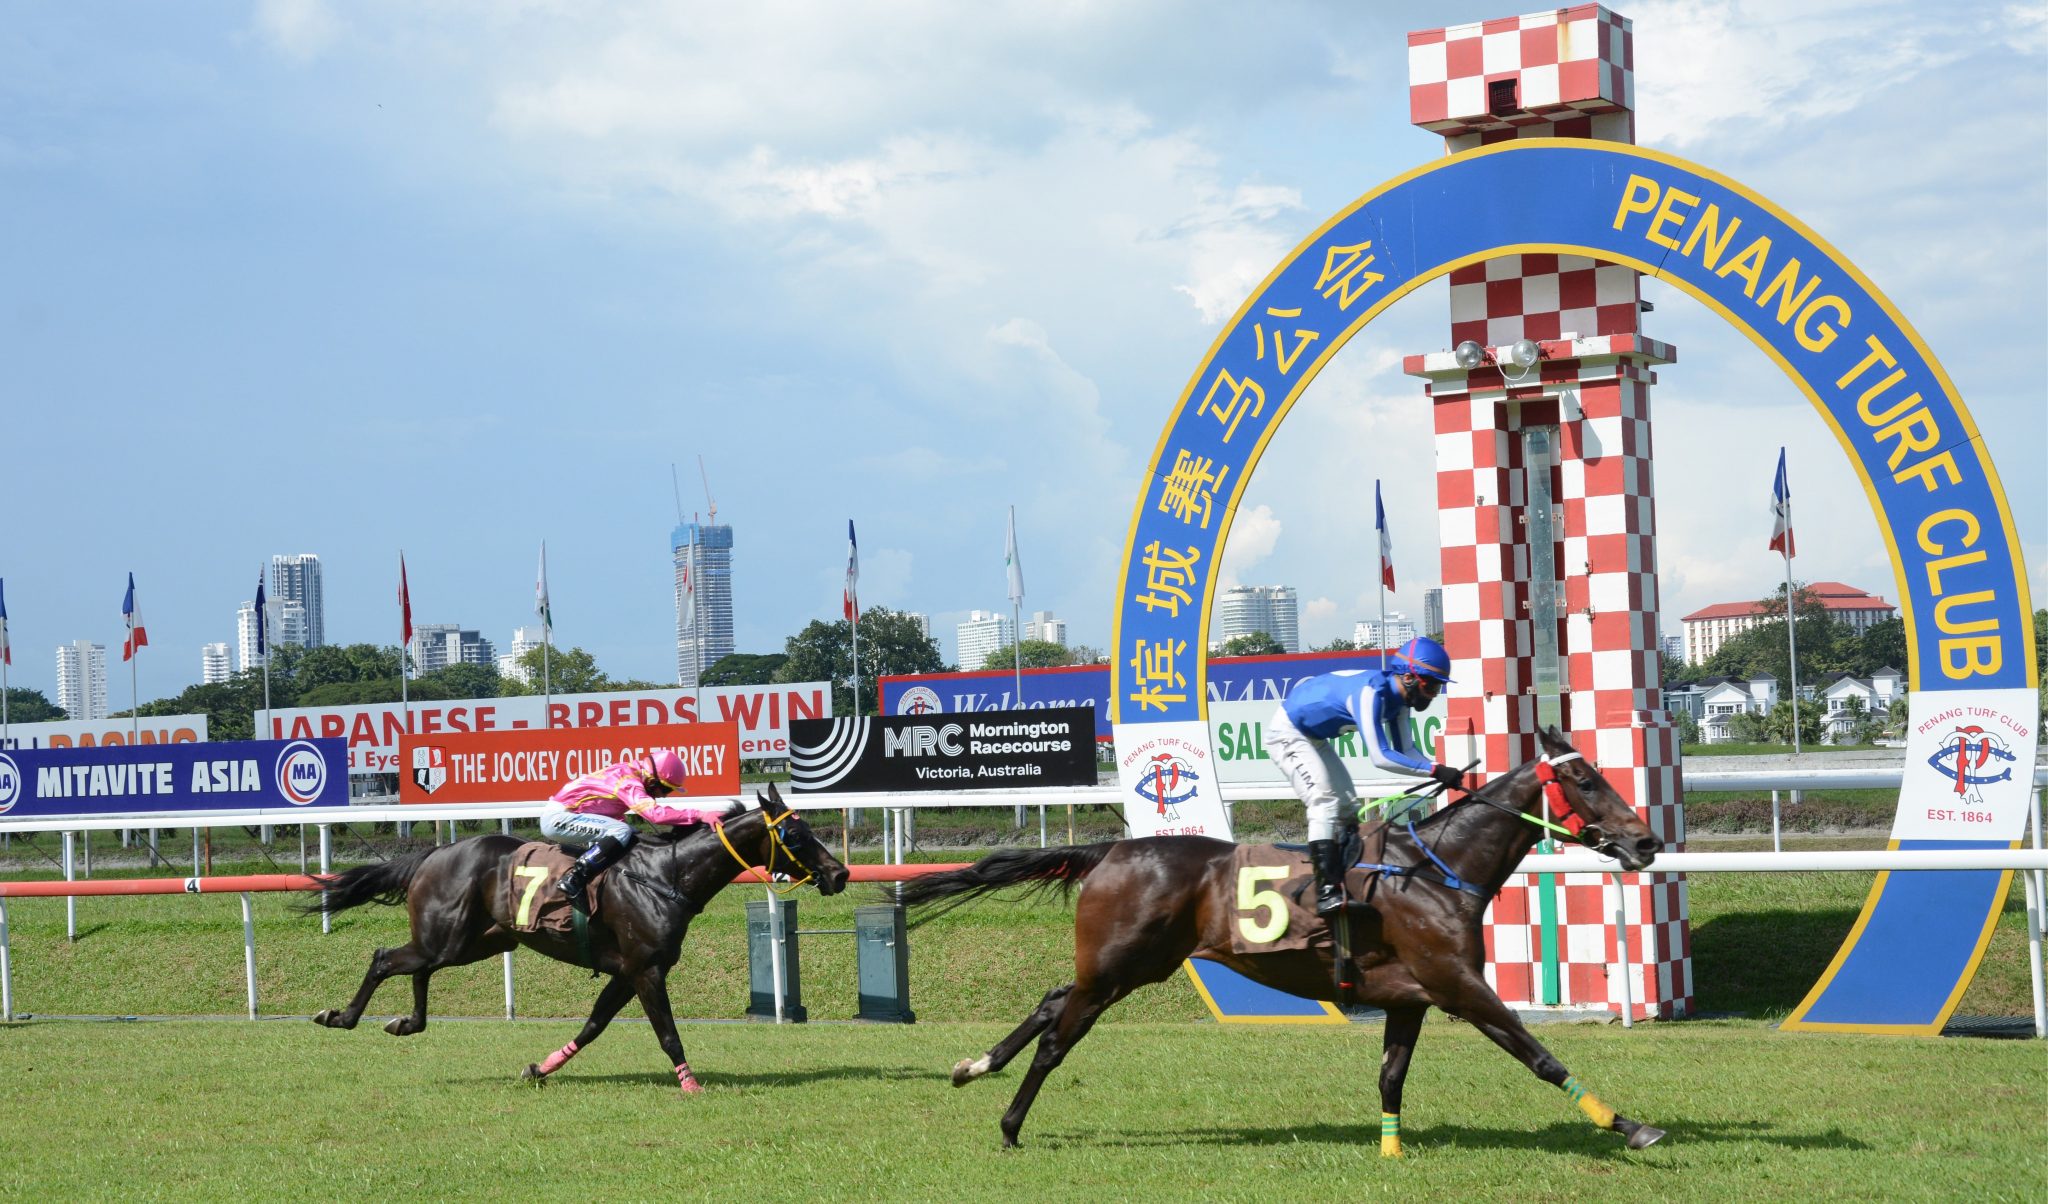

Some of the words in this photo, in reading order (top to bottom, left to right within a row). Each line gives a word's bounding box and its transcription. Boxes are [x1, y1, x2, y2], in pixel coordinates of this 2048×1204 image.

[1612, 173, 1852, 353] PENANG
[1836, 334, 1963, 492] TURF
[1916, 508, 2003, 680] CLUB
[1130, 239, 1385, 712] 槟城赛马公会
[273, 707, 496, 748] JAPANESE
[546, 696, 698, 728] BREDS
[717, 690, 823, 731] WIN
[969, 721, 1069, 741] Mornington
[1918, 707, 1964, 735] PENANG
[1967, 706, 1998, 720] TURF
[1999, 714, 2029, 738] CLUB
[884, 723, 964, 758] MRC
[970, 739, 1071, 755] Racecourse
[1123, 740, 1155, 768] PENANG
[1157, 738, 1181, 746] TURF
[1182, 742, 1206, 759] CLUB
[37, 762, 173, 798] MITAVITE
[191, 759, 261, 793] ASIA
[292, 763, 317, 780] MA
[451, 752, 487, 784] THE
[492, 750, 560, 783] JOCKEY
[566, 748, 613, 780] CLUB
[650, 744, 725, 777] RKEY
[916, 765, 974, 779] Victoria,
[977, 763, 1042, 777] Australia
[1180, 825, 1205, 836] 1864
[1927, 809, 1957, 822] EST.
[1961, 811, 1993, 823] 1864
[187, 879, 198, 893] 4
[513, 866, 549, 926] 7
[1237, 865, 1290, 944] 5
